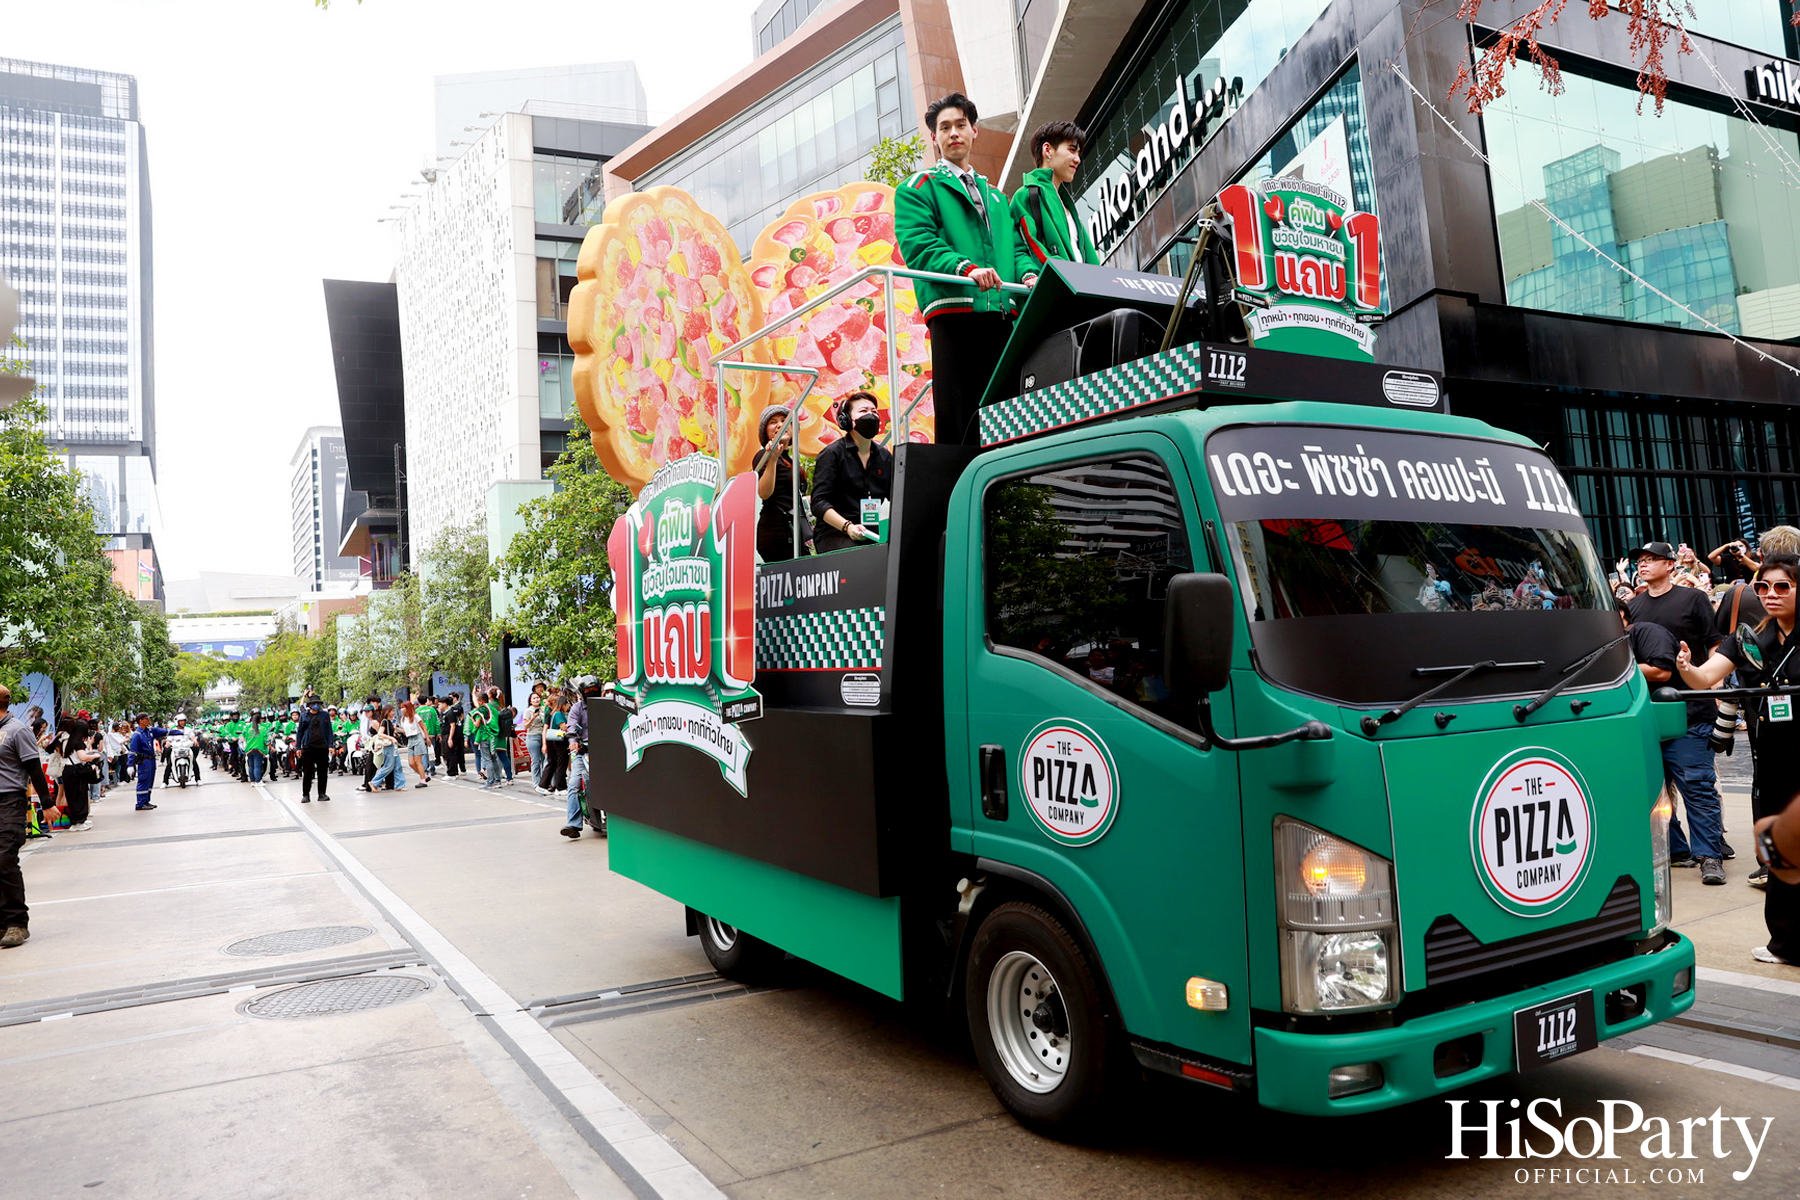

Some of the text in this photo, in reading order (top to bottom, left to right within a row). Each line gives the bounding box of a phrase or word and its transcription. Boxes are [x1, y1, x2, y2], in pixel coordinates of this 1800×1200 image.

[1087, 172, 1132, 247] niko
[1290, 199, 1324, 228] คู่ฟิน
[1330, 193, 1346, 208] 1112
[1218, 184, 1380, 308] 1 แถม 1
[1274, 229, 1342, 255] ขวัญใจมหาชน
[1116, 277, 1146, 291] THE
[1261, 310, 1365, 339] ทุกหน้า ทุกขอบ ทุกที่ทั่วไทย
[1208, 353, 1247, 381] 1112
[699, 462, 717, 484] 1112
[1209, 451, 1300, 497] เดอะ
[1300, 443, 1398, 499] พิซซ่า
[1398, 456, 1506, 506] คอมปะนี
[660, 505, 691, 557] คู่ฟิน
[607, 472, 758, 683] 1 แถม 1
[643, 563, 709, 595] ขวัญใจมหาชน
[760, 572, 795, 609] PIZZA
[796, 570, 840, 599] COMPANY
[632, 712, 733, 755] ทุกหน้า ทุกขอบ ทุกที่ทั่วไทย
[1057, 741, 1072, 756] THE
[1033, 756, 1099, 808] PIZZA
[1525, 777, 1543, 796] THE
[1048, 805, 1085, 826] COMPANY
[1494, 798, 1578, 868] PIZZA
[1516, 863, 1562, 889] COMPANY
[1537, 1007, 1577, 1053] 1112
